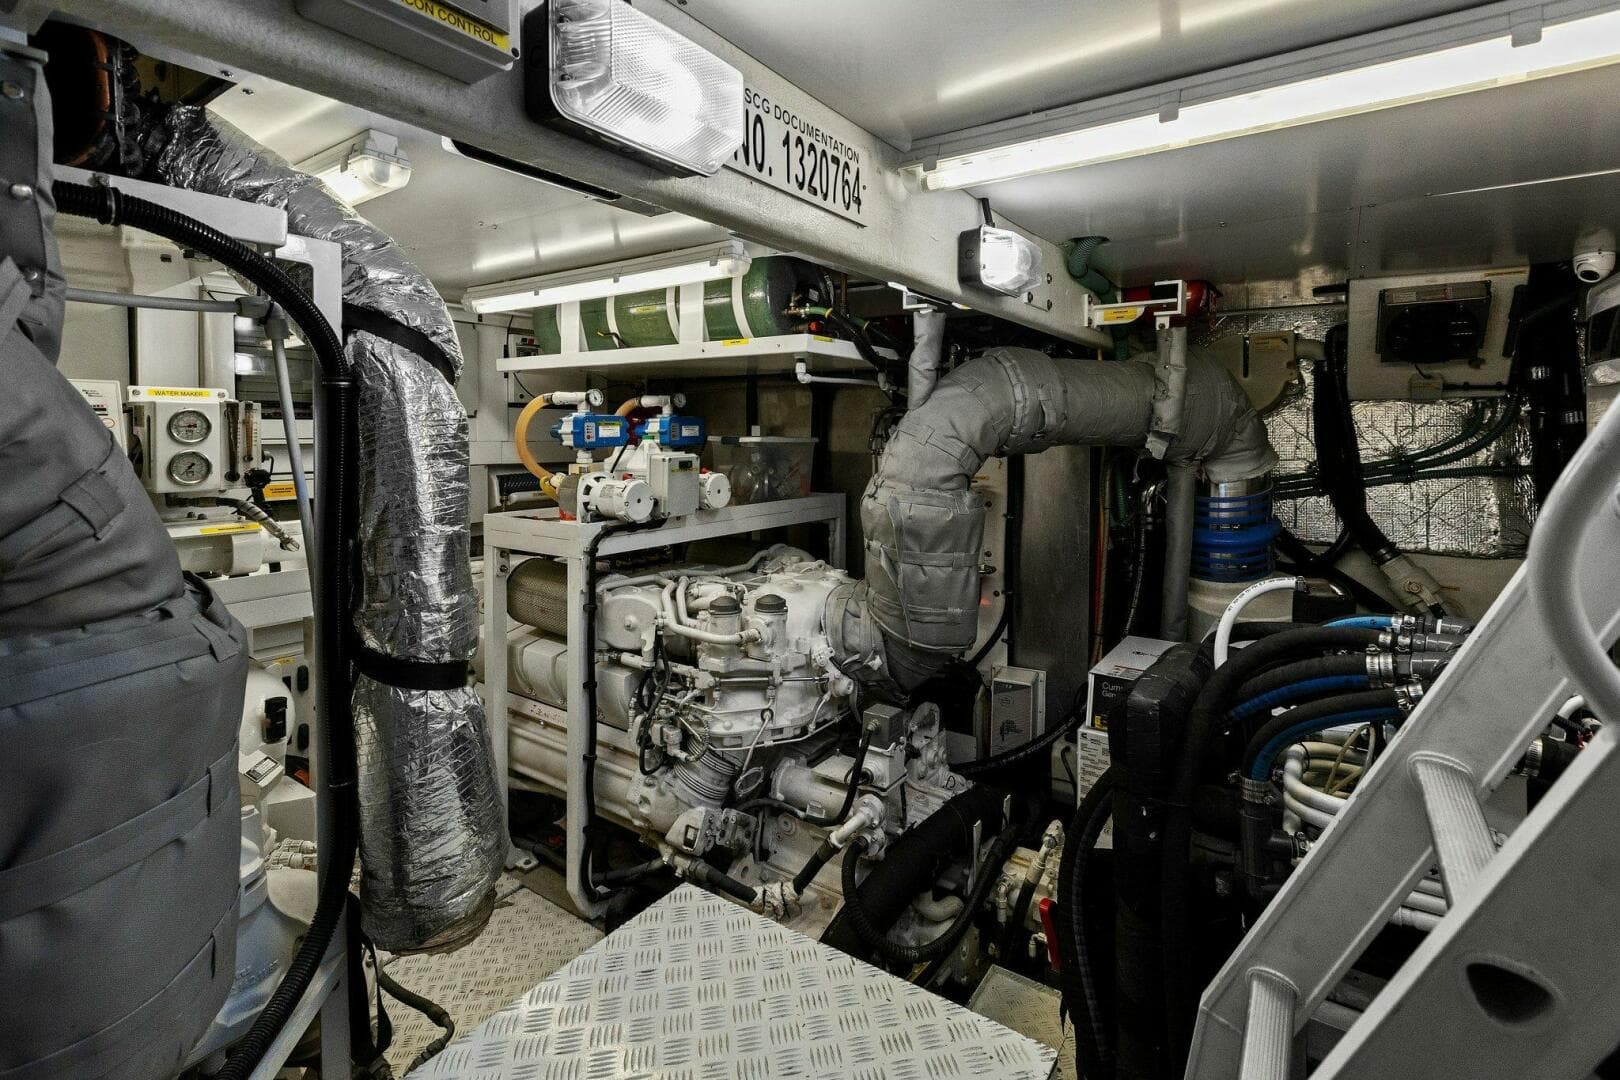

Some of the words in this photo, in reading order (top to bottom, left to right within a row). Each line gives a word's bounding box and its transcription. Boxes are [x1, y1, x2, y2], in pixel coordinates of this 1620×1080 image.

[437, 8, 498, 46] CONTROL
[774, 104, 860, 165] DOCUMENTATION
[782, 129, 862, 215] 1320764
